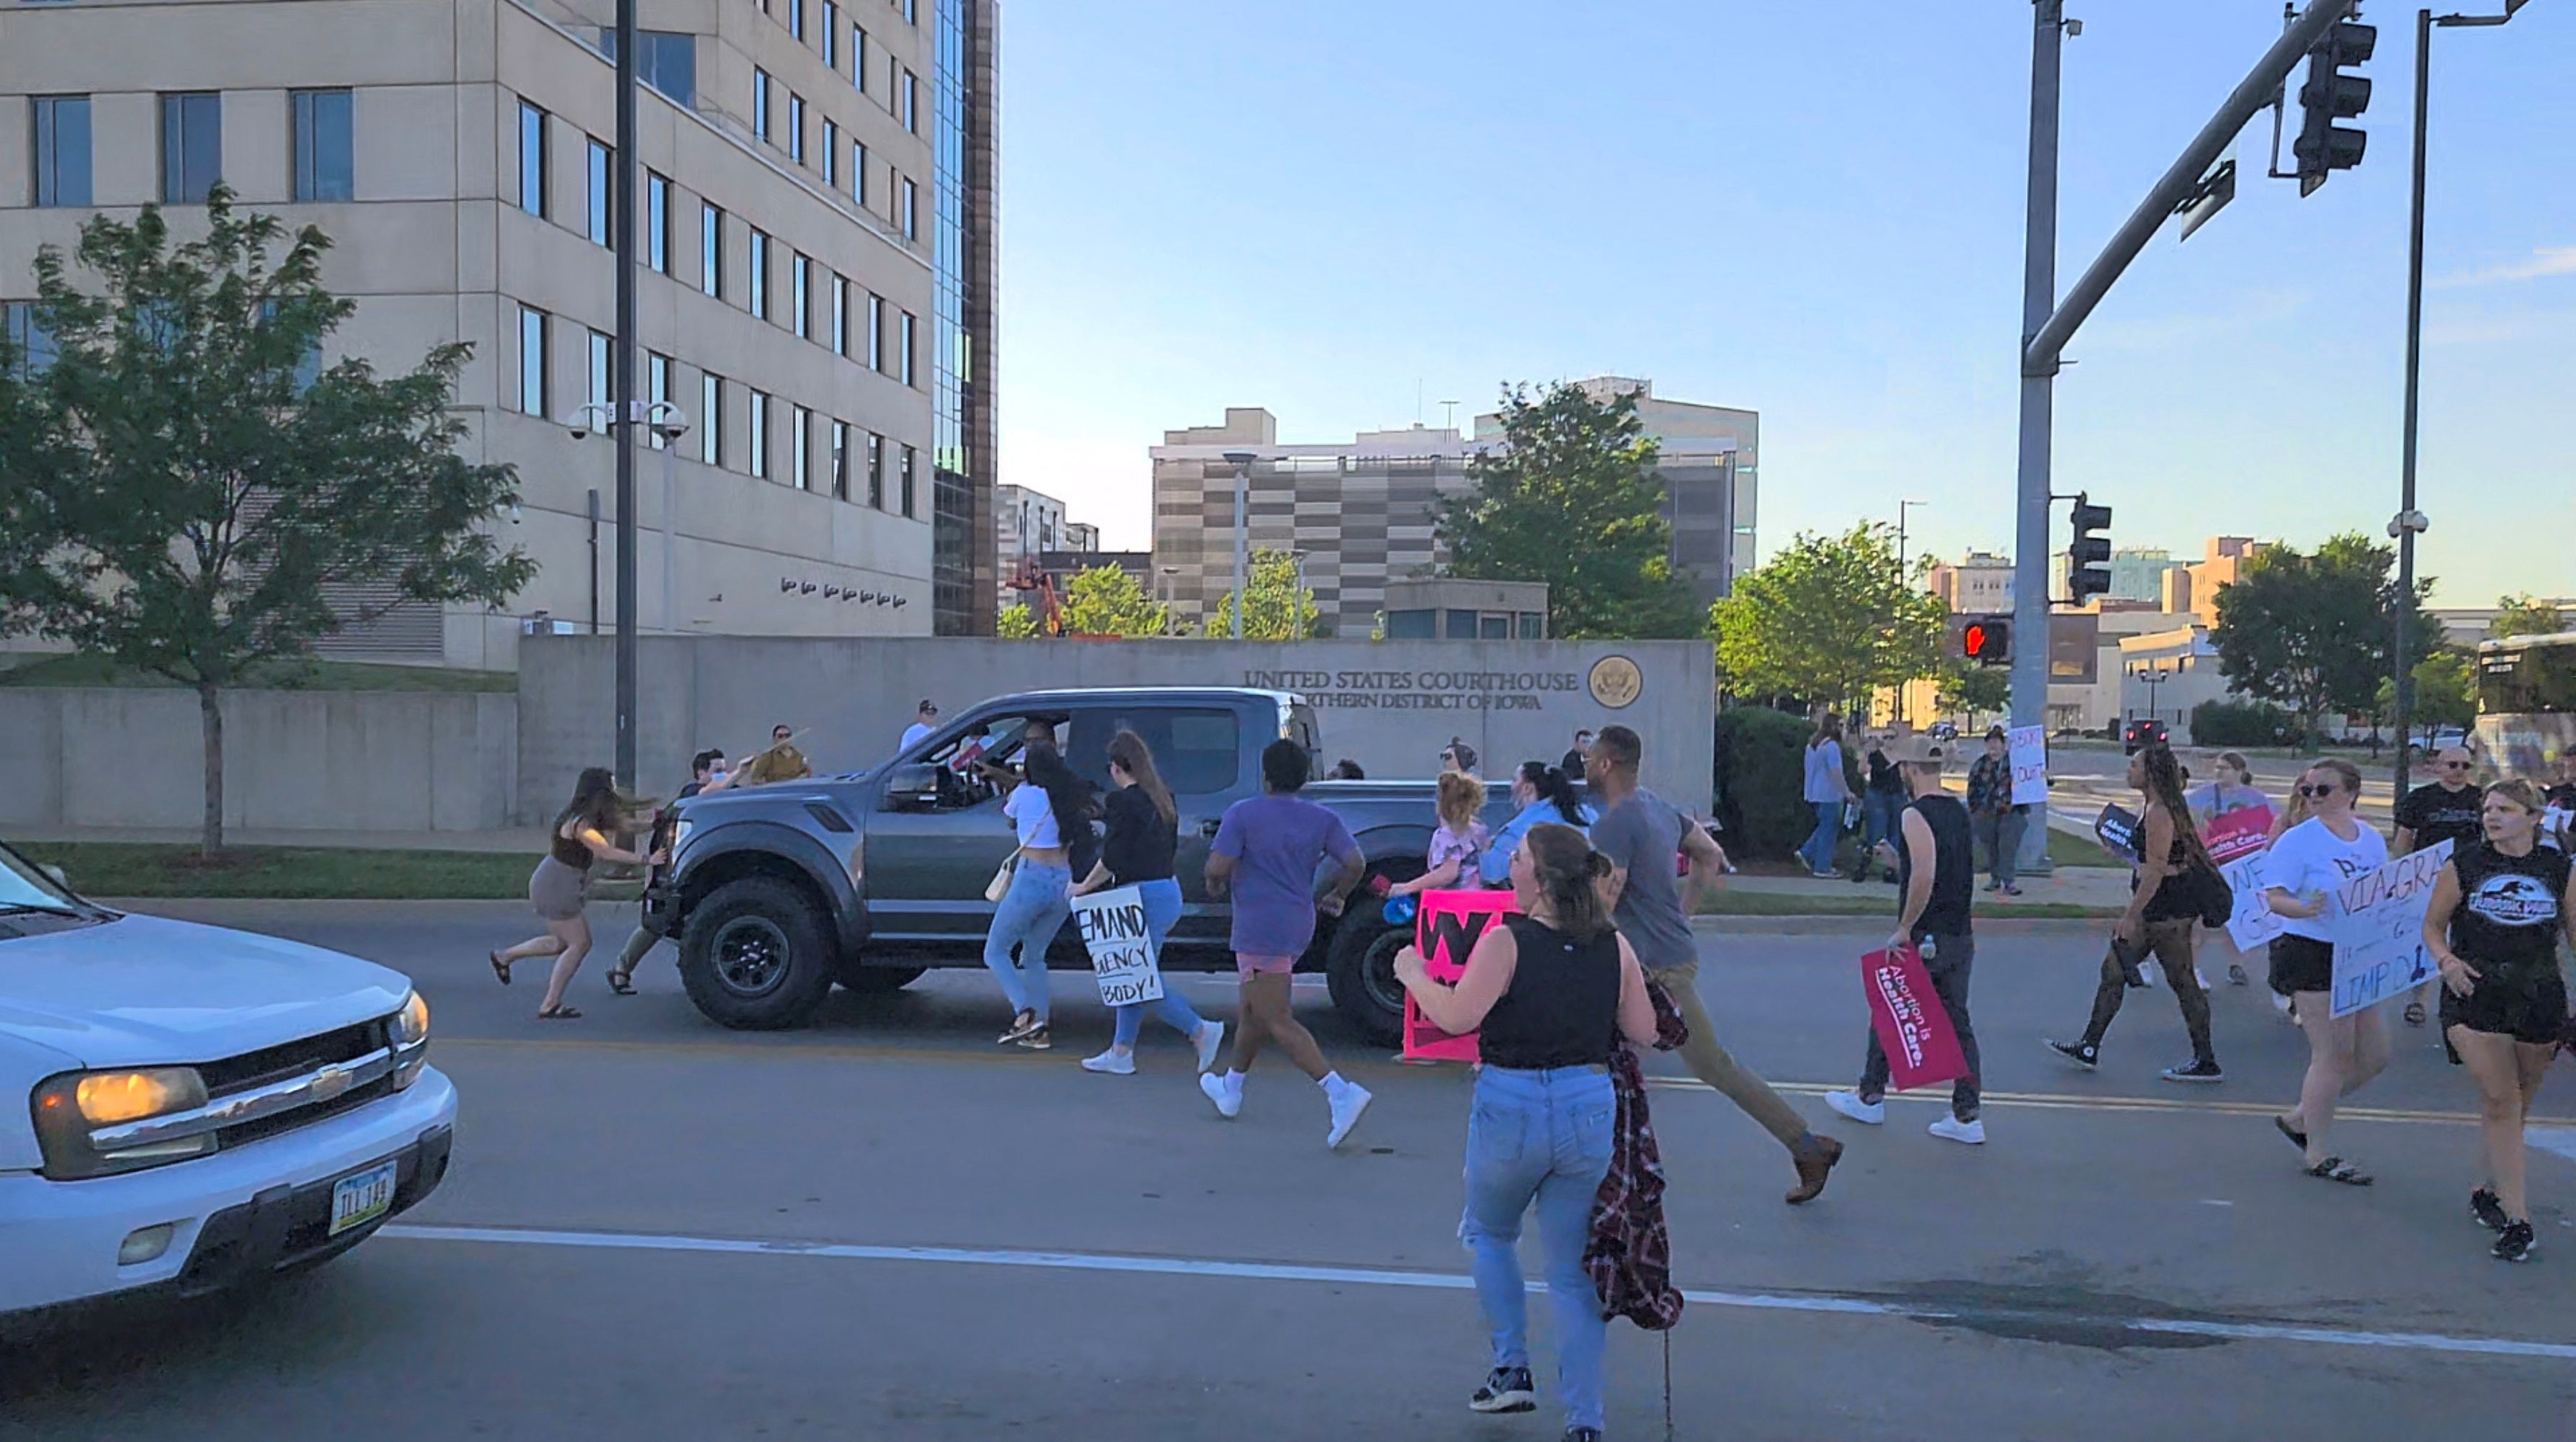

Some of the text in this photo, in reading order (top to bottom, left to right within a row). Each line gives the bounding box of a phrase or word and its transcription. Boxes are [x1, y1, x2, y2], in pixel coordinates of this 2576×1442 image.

[1244, 671, 1580, 691] UNITED STATES COURTHOUSE
[1305, 692, 1543, 711] RTHERN DISTRICT OF IOWA
[1075, 904, 1146, 942] EMAND
[1101, 974, 1155, 1004] BODY!
[1888, 965, 1932, 1041] Abortion is
[1878, 967, 1923, 1067] Health Care.
